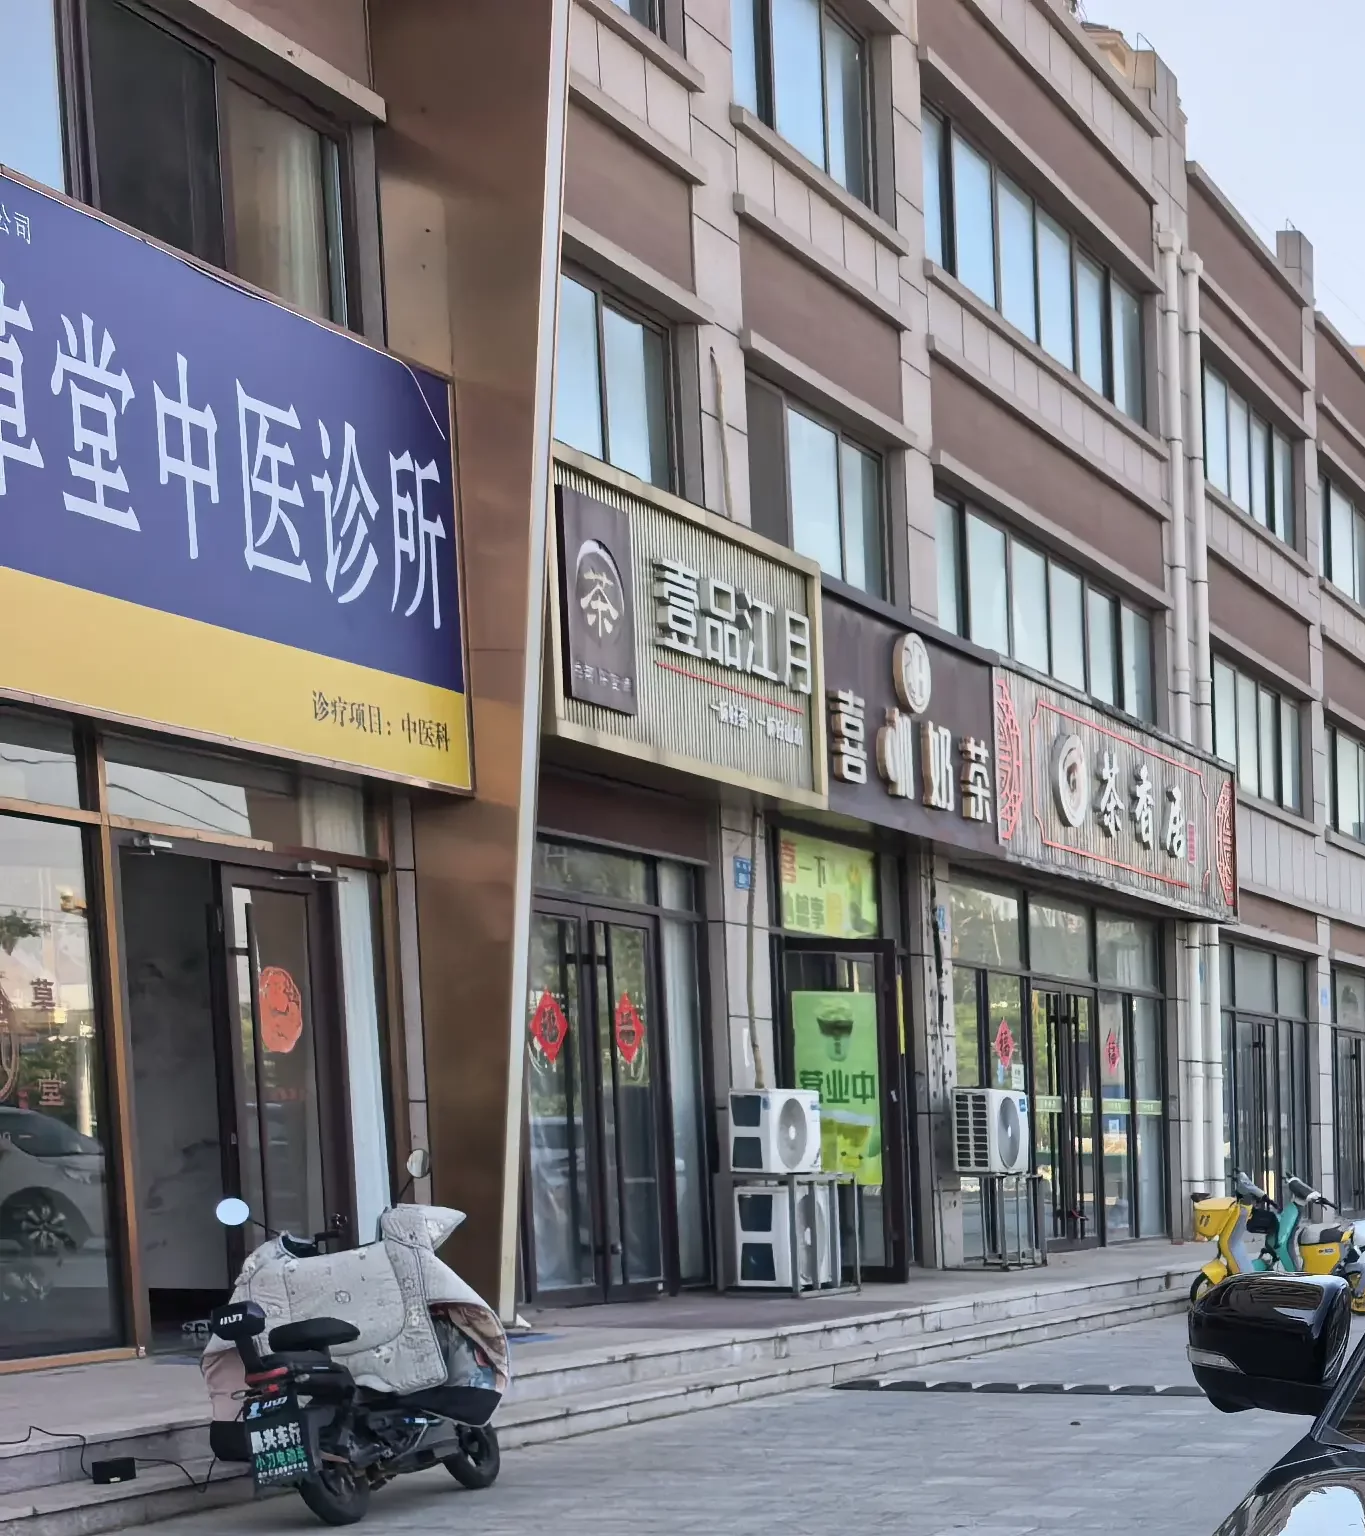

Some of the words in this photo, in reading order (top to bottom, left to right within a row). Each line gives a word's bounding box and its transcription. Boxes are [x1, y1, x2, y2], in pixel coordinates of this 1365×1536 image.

[580, 567, 619, 641] 茶
[654, 557, 811, 695] 壹品江月
[799, 1070, 875, 1104] 营业中
